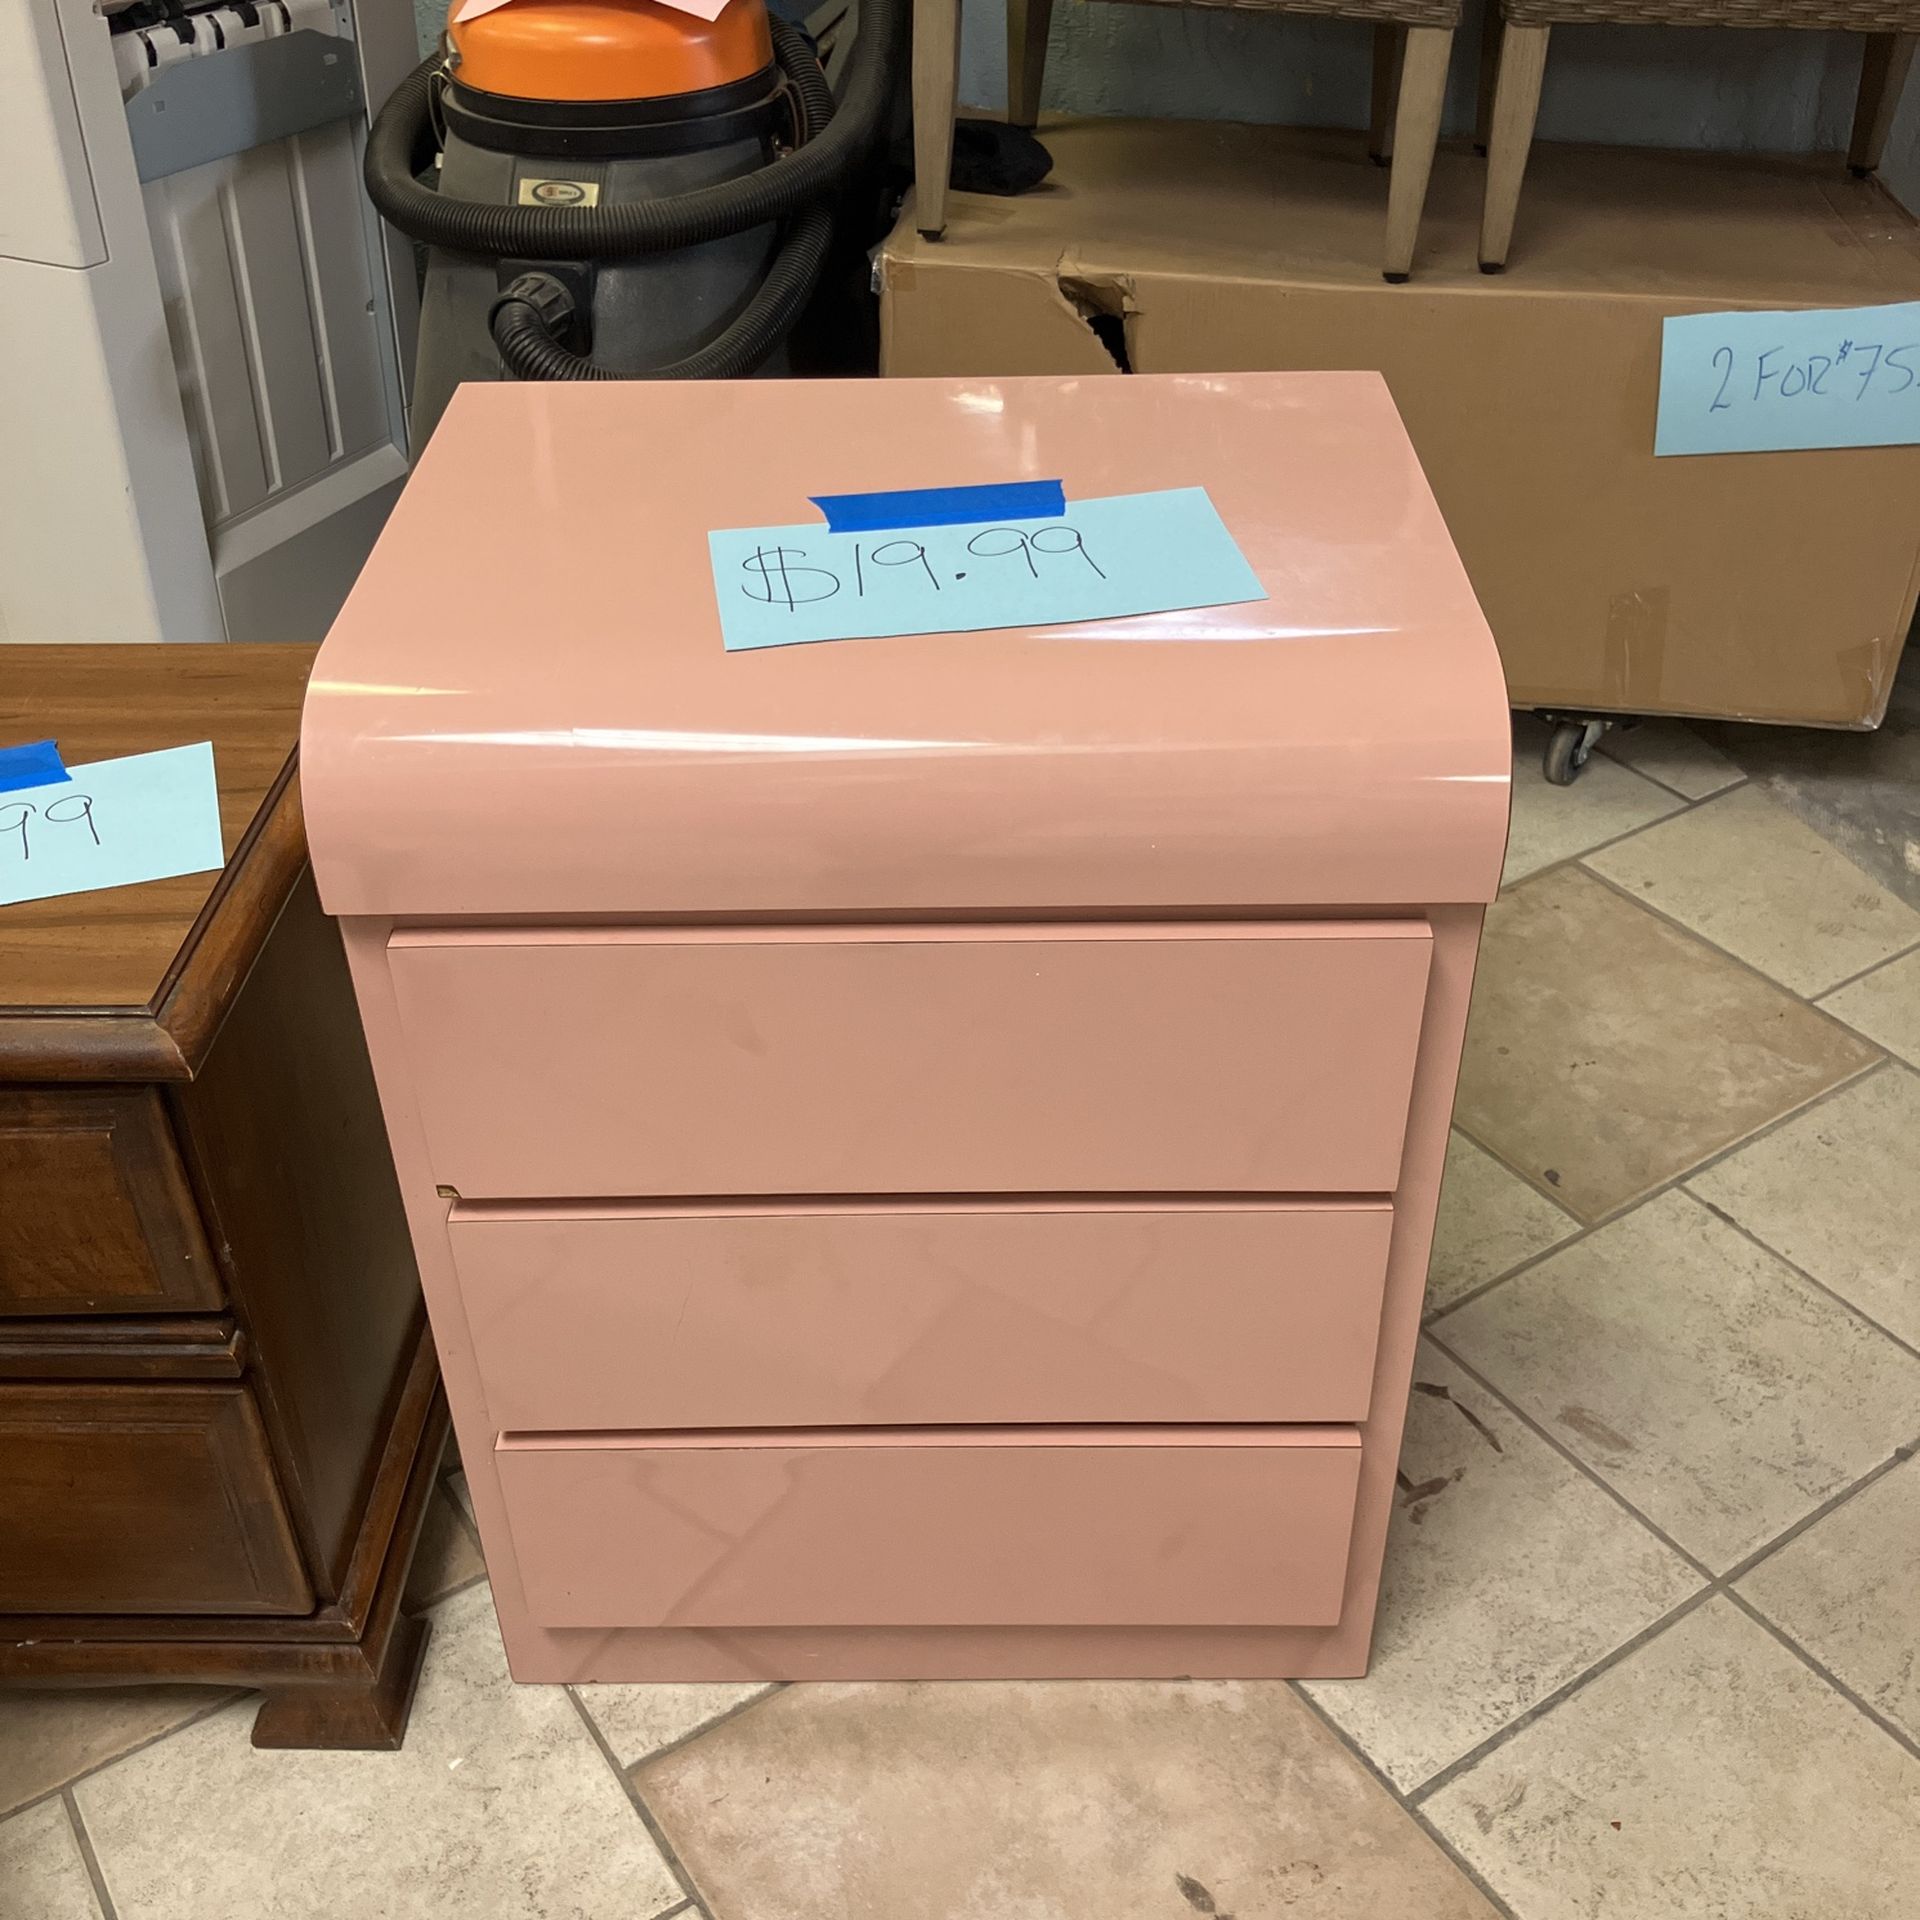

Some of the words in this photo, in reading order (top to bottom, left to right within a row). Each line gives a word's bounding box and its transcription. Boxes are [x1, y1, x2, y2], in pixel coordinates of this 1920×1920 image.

[1709, 346, 1734, 413] 2
[1753, 345, 1832, 401] FOR
[741, 526, 1107, 613] $19.99
